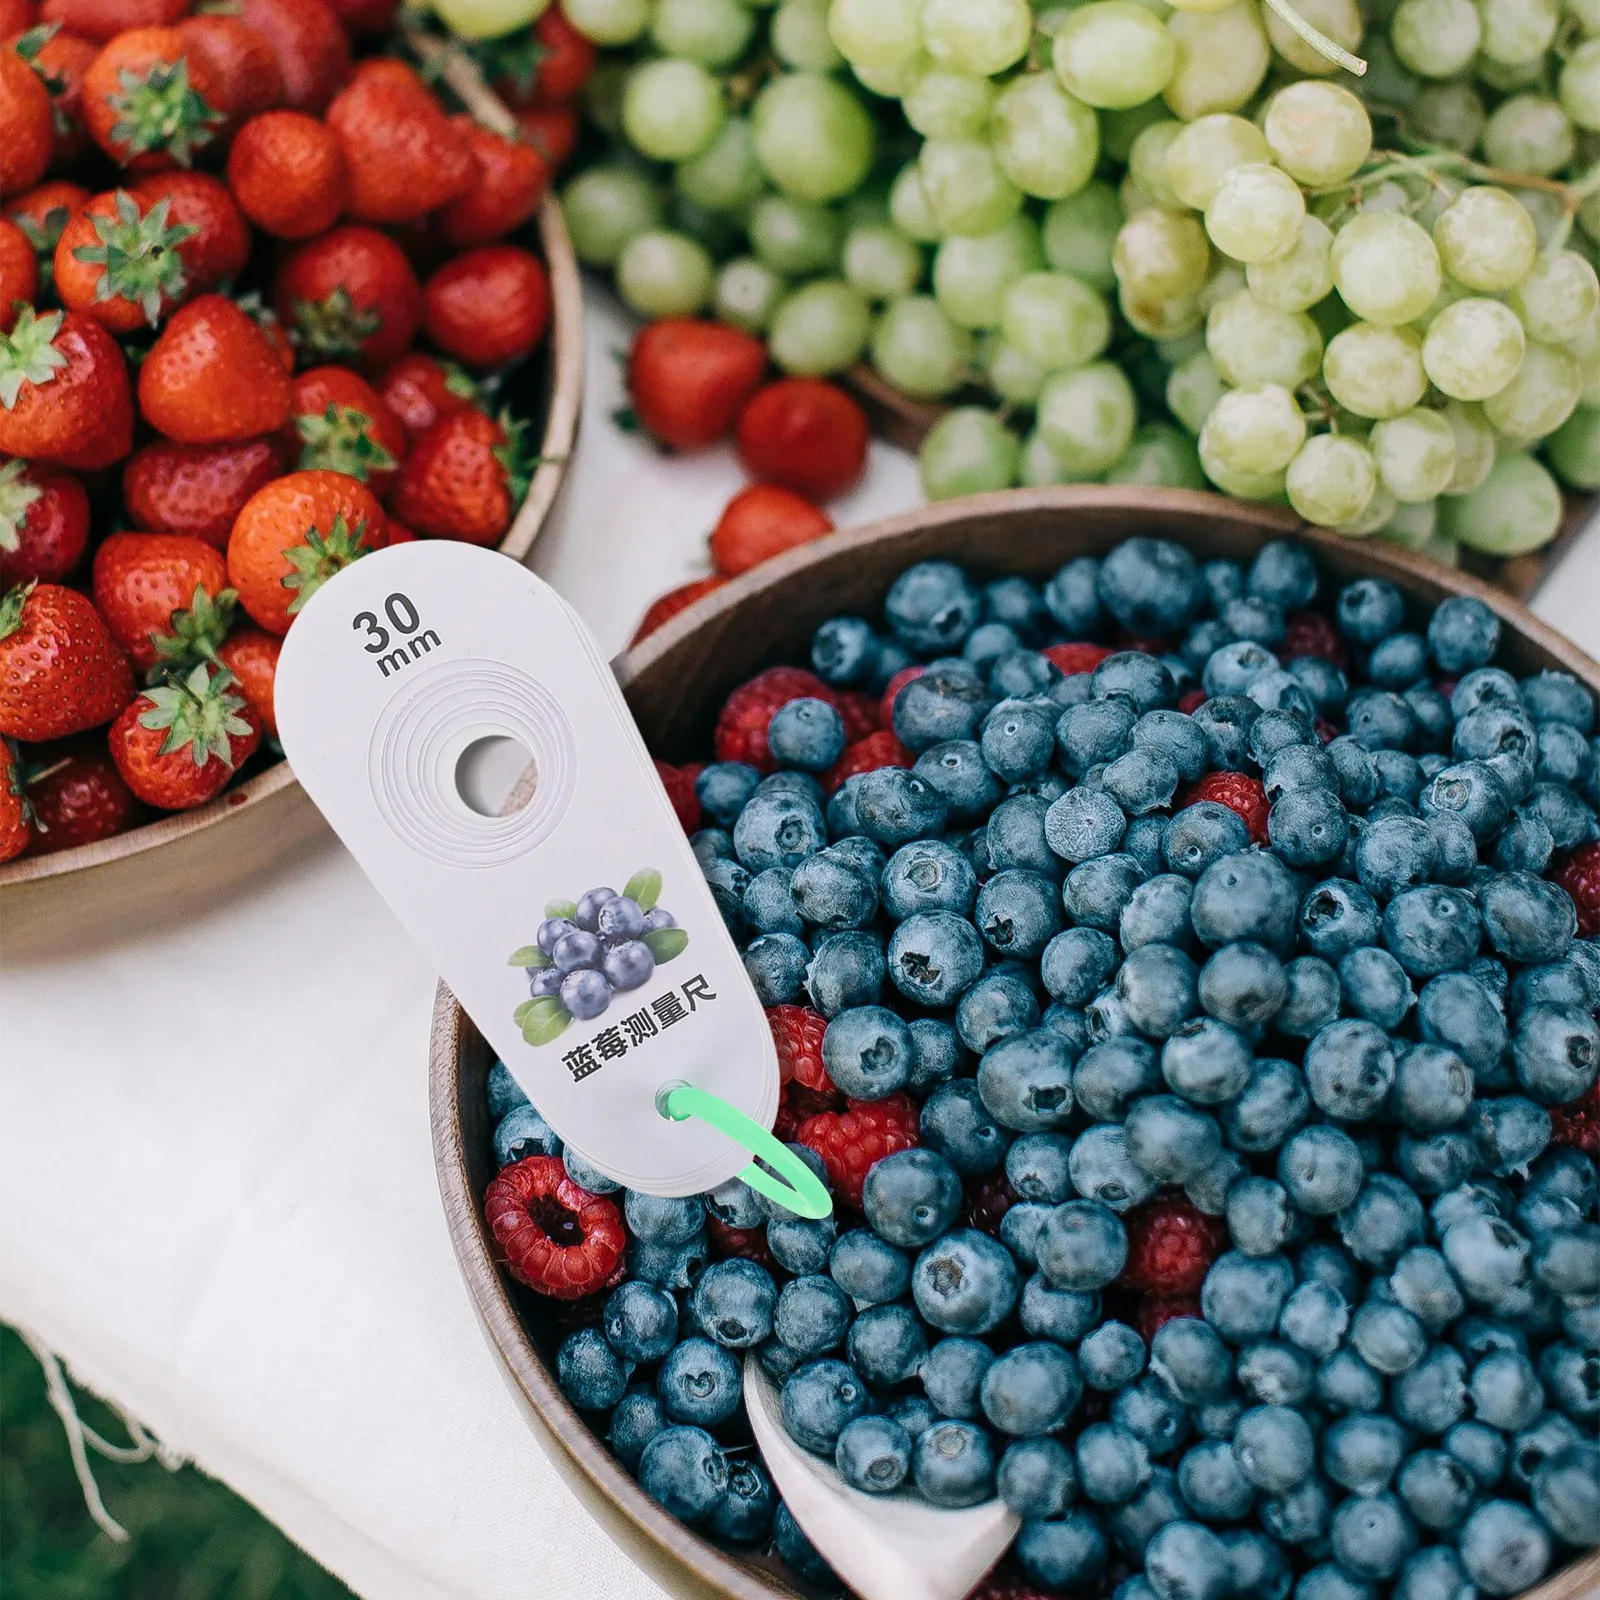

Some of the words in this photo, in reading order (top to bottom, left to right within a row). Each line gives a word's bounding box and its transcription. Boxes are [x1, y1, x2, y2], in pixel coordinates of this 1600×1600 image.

[352, 592, 420, 654] 30
[376, 629, 442, 678] mm
[561, 973, 717, 1083] 蓝莓测量尺
